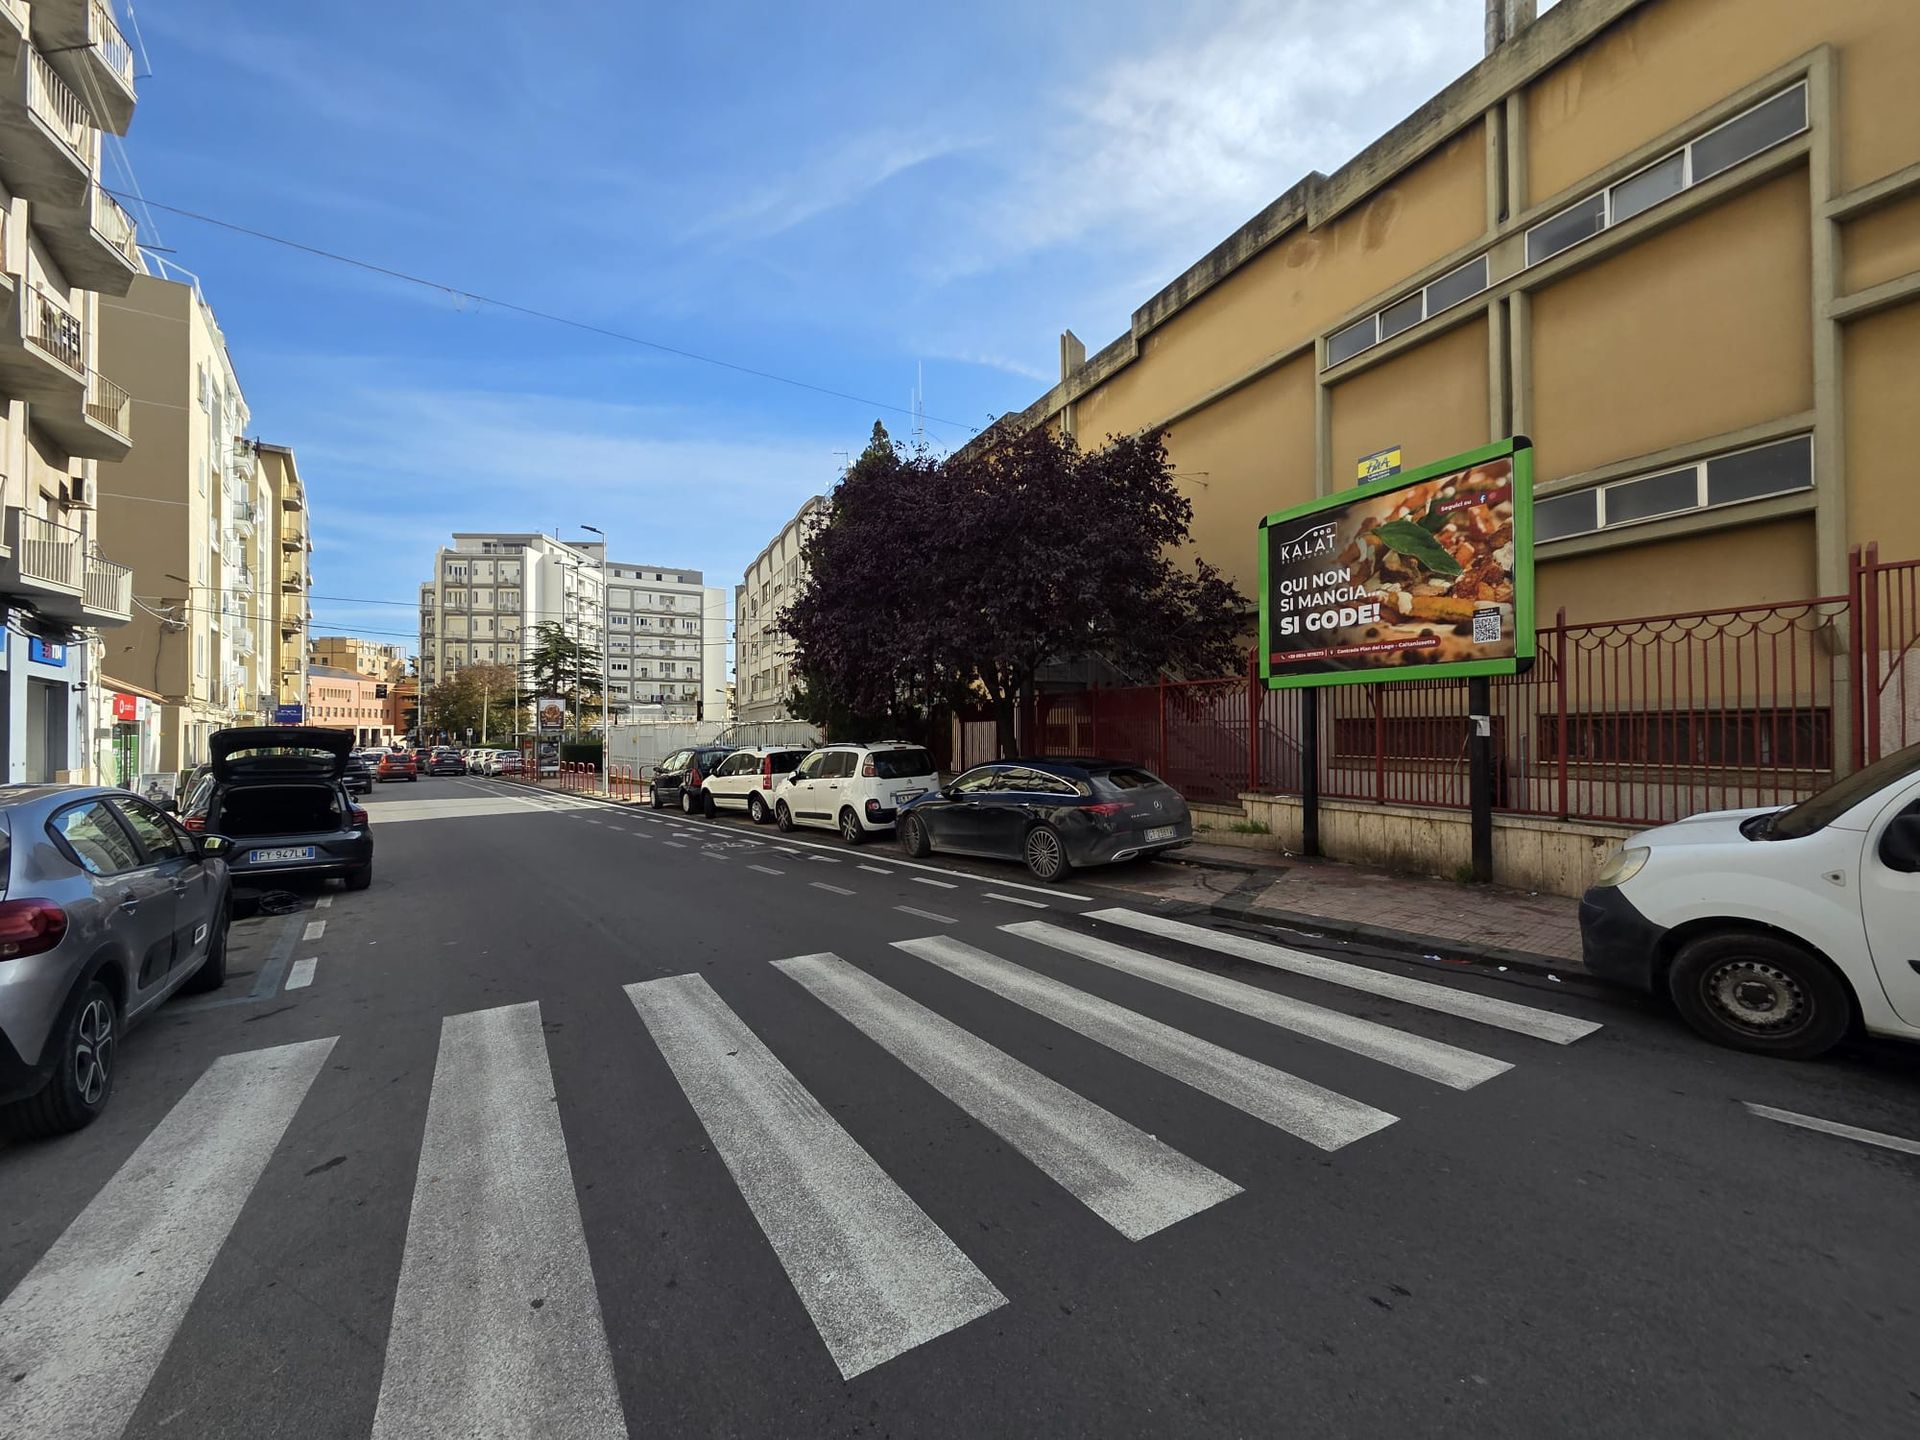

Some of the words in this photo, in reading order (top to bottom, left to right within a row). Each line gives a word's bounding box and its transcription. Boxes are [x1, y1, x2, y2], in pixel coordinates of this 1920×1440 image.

[1282, 534, 1336, 560] KALAT
[1280, 577, 1307, 595] QUI
[1313, 568, 1350, 588] NON
[1280, 597, 1293, 612] SI
[1298, 585, 1379, 609] MANGIA...
[1281, 616, 1300, 635] SI
[1305, 603, 1381, 631] GODE!
[259, 851, 271, 860] FY
